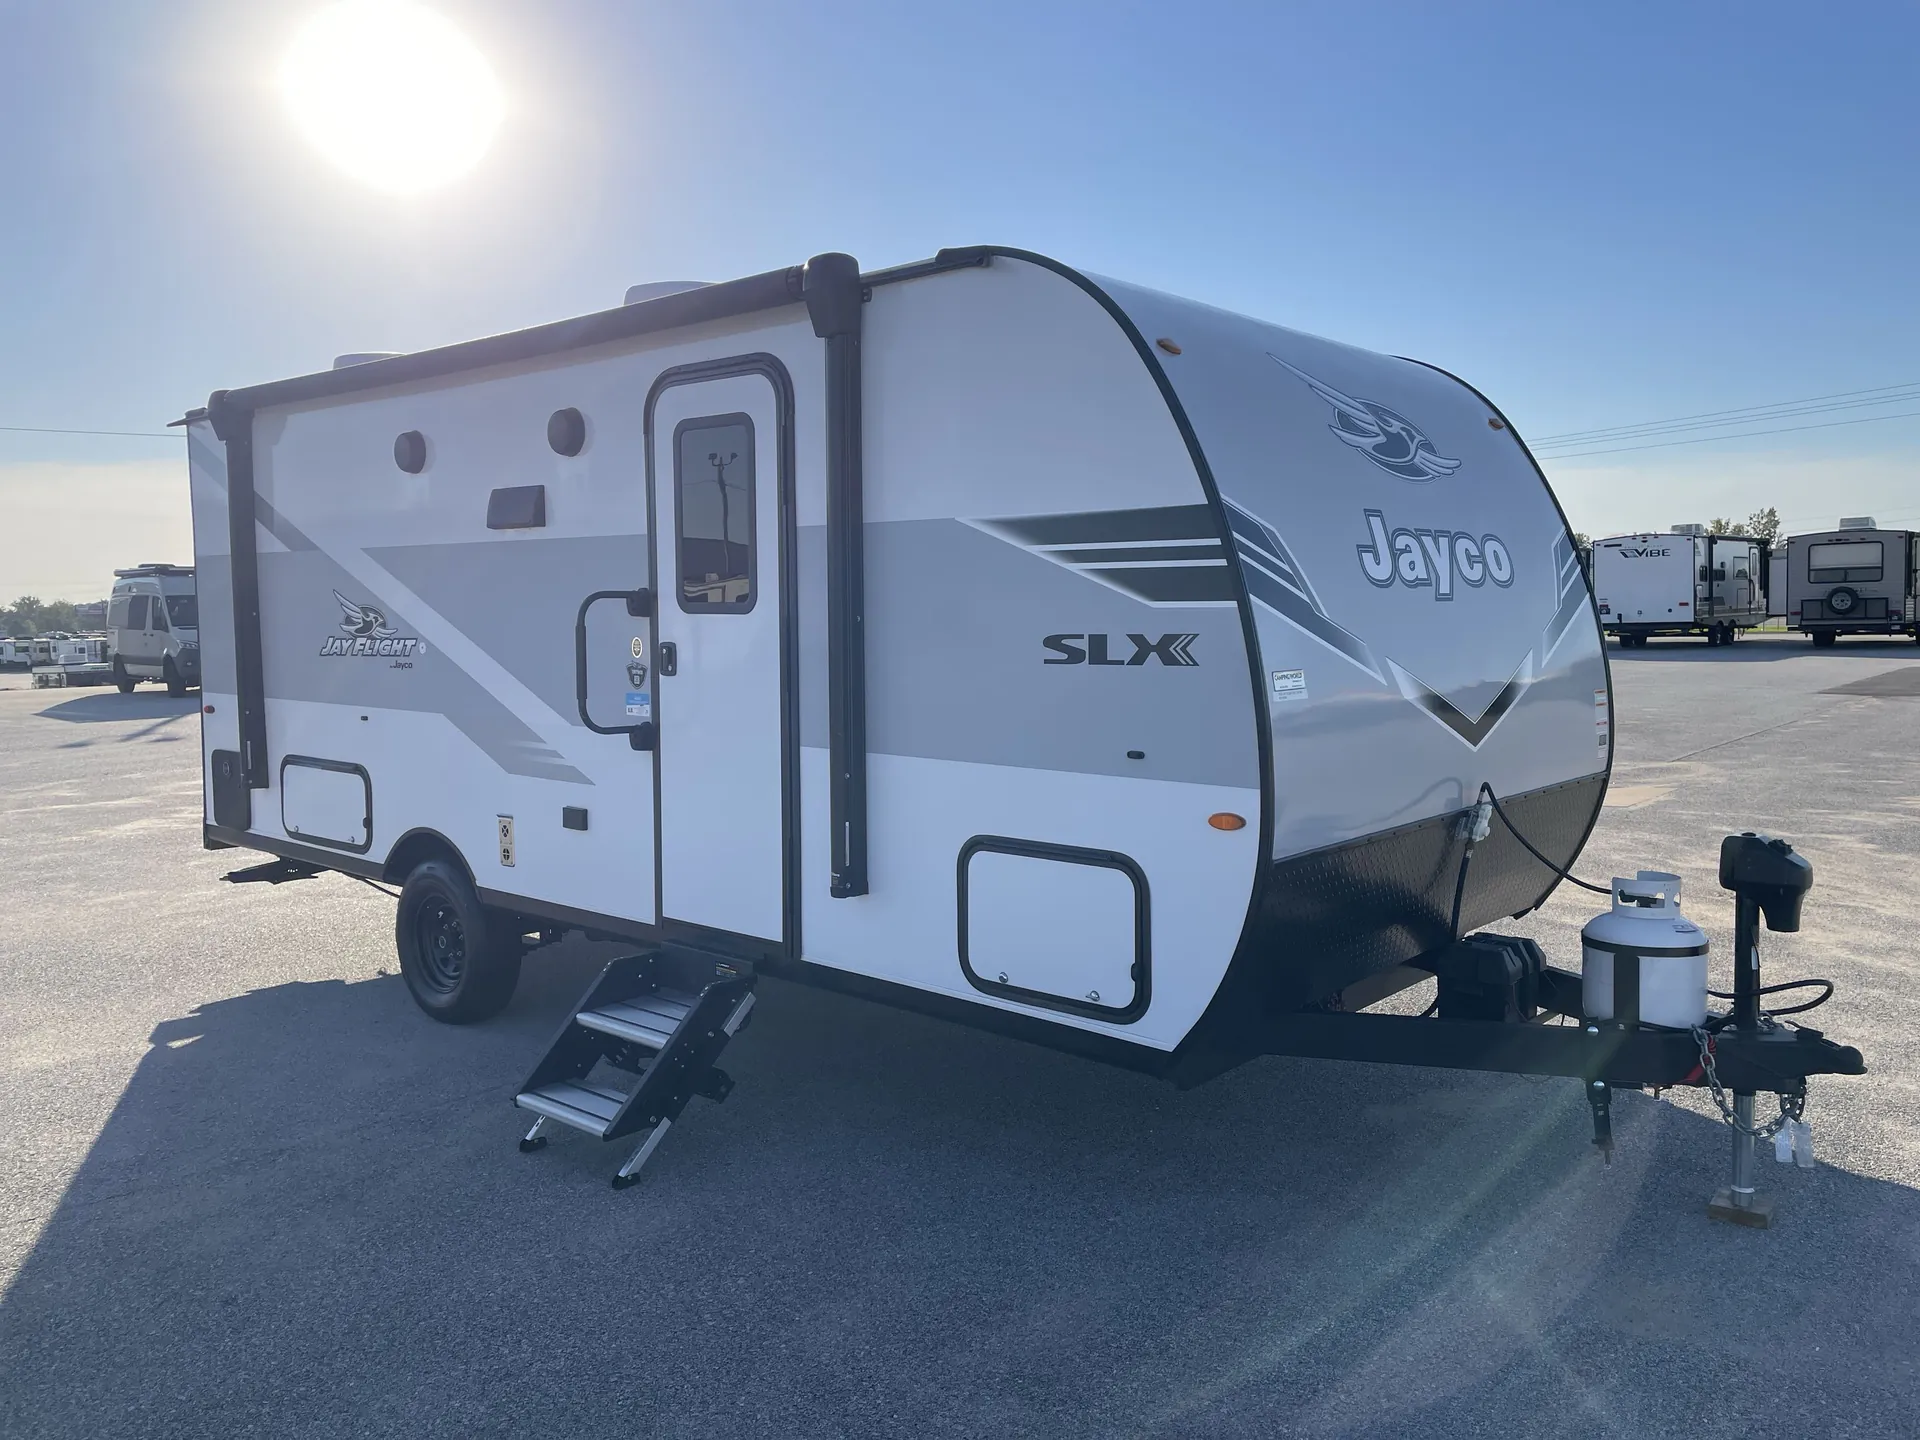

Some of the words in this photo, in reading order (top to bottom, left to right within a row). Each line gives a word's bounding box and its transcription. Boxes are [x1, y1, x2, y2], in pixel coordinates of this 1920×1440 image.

[1356, 508, 1514, 601] Jayco
[1634, 548, 1671, 558] VIBE
[319, 636, 354, 656] JAY
[351, 637, 418, 657] FLIGHT
[1042, 633, 1200, 667] SLX
[393, 660, 413, 670] Jayco
